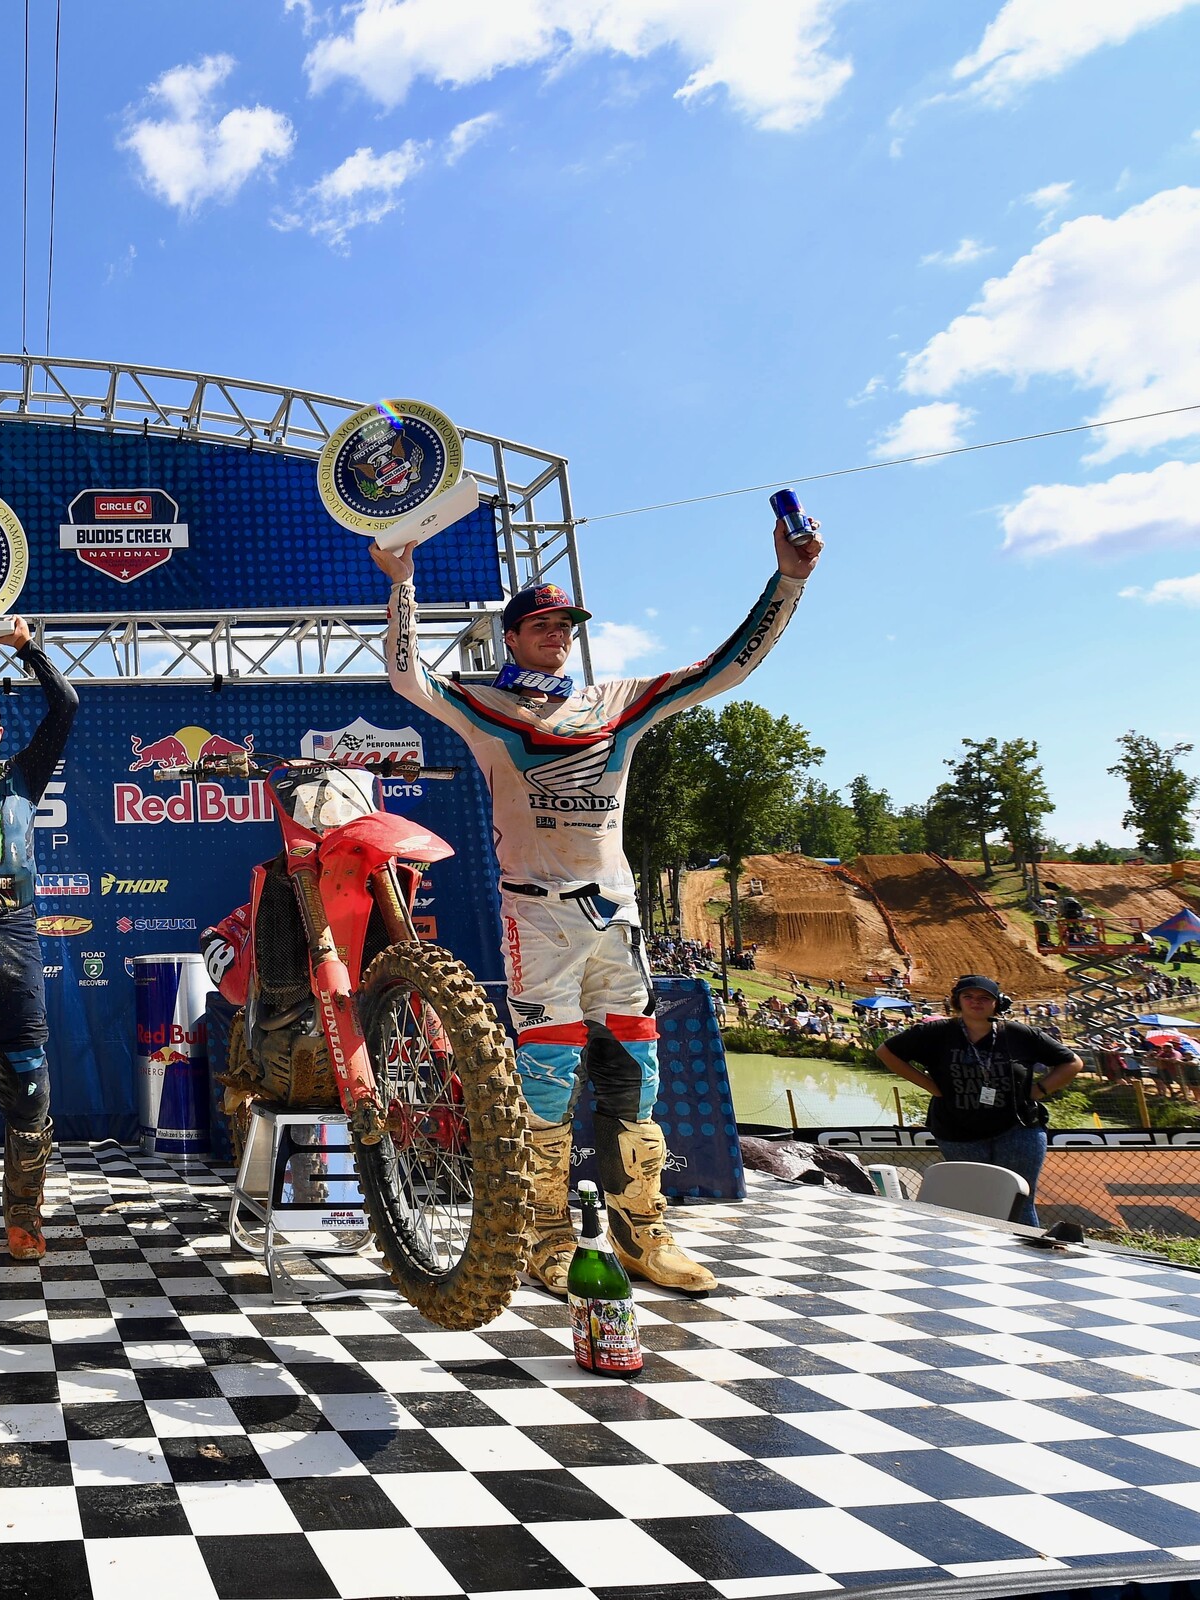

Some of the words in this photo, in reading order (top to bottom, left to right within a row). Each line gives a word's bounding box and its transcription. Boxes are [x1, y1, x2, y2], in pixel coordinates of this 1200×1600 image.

[408, 403, 460, 468] CHAMPIONSHIP
[328, 439, 340, 461] PRO
[321, 462, 332, 481] OIL
[322, 482, 344, 513] LUCAS
[100, 503, 132, 511] CIRCLE
[76, 529, 123, 544] BUDDS
[126, 528, 172, 543] CREEK
[734, 599, 785, 668] HONDA
[513, 670, 573, 698] 100%
[301, 766, 334, 776] LUCAS
[383, 784, 423, 798] UCTS
[114, 781, 194, 824] Red
[198, 780, 274, 823] Bull
[530, 794, 619, 811] HONDA
[36, 874, 90, 886] ARTS
[116, 879, 169, 894] THOR
[35, 887, 90, 895] LIMITED
[412, 898, 435, 907] LY
[134, 918, 197, 931] SUZUKI
[504, 915, 524, 997] ASTARS
[89, 964, 98, 976] 2
[78, 979, 109, 987] RECOVERY
[518, 1015, 553, 1029] HONDA
[137, 1023, 165, 1045] Red
[169, 1024, 208, 1045] Bull
[319, 990, 349, 1081] DUNLOP
[955, 1092, 1006, 1110] LIVS
[157, 1130, 179, 1139] Vitalizes
[179, 1130, 197, 1140] body
